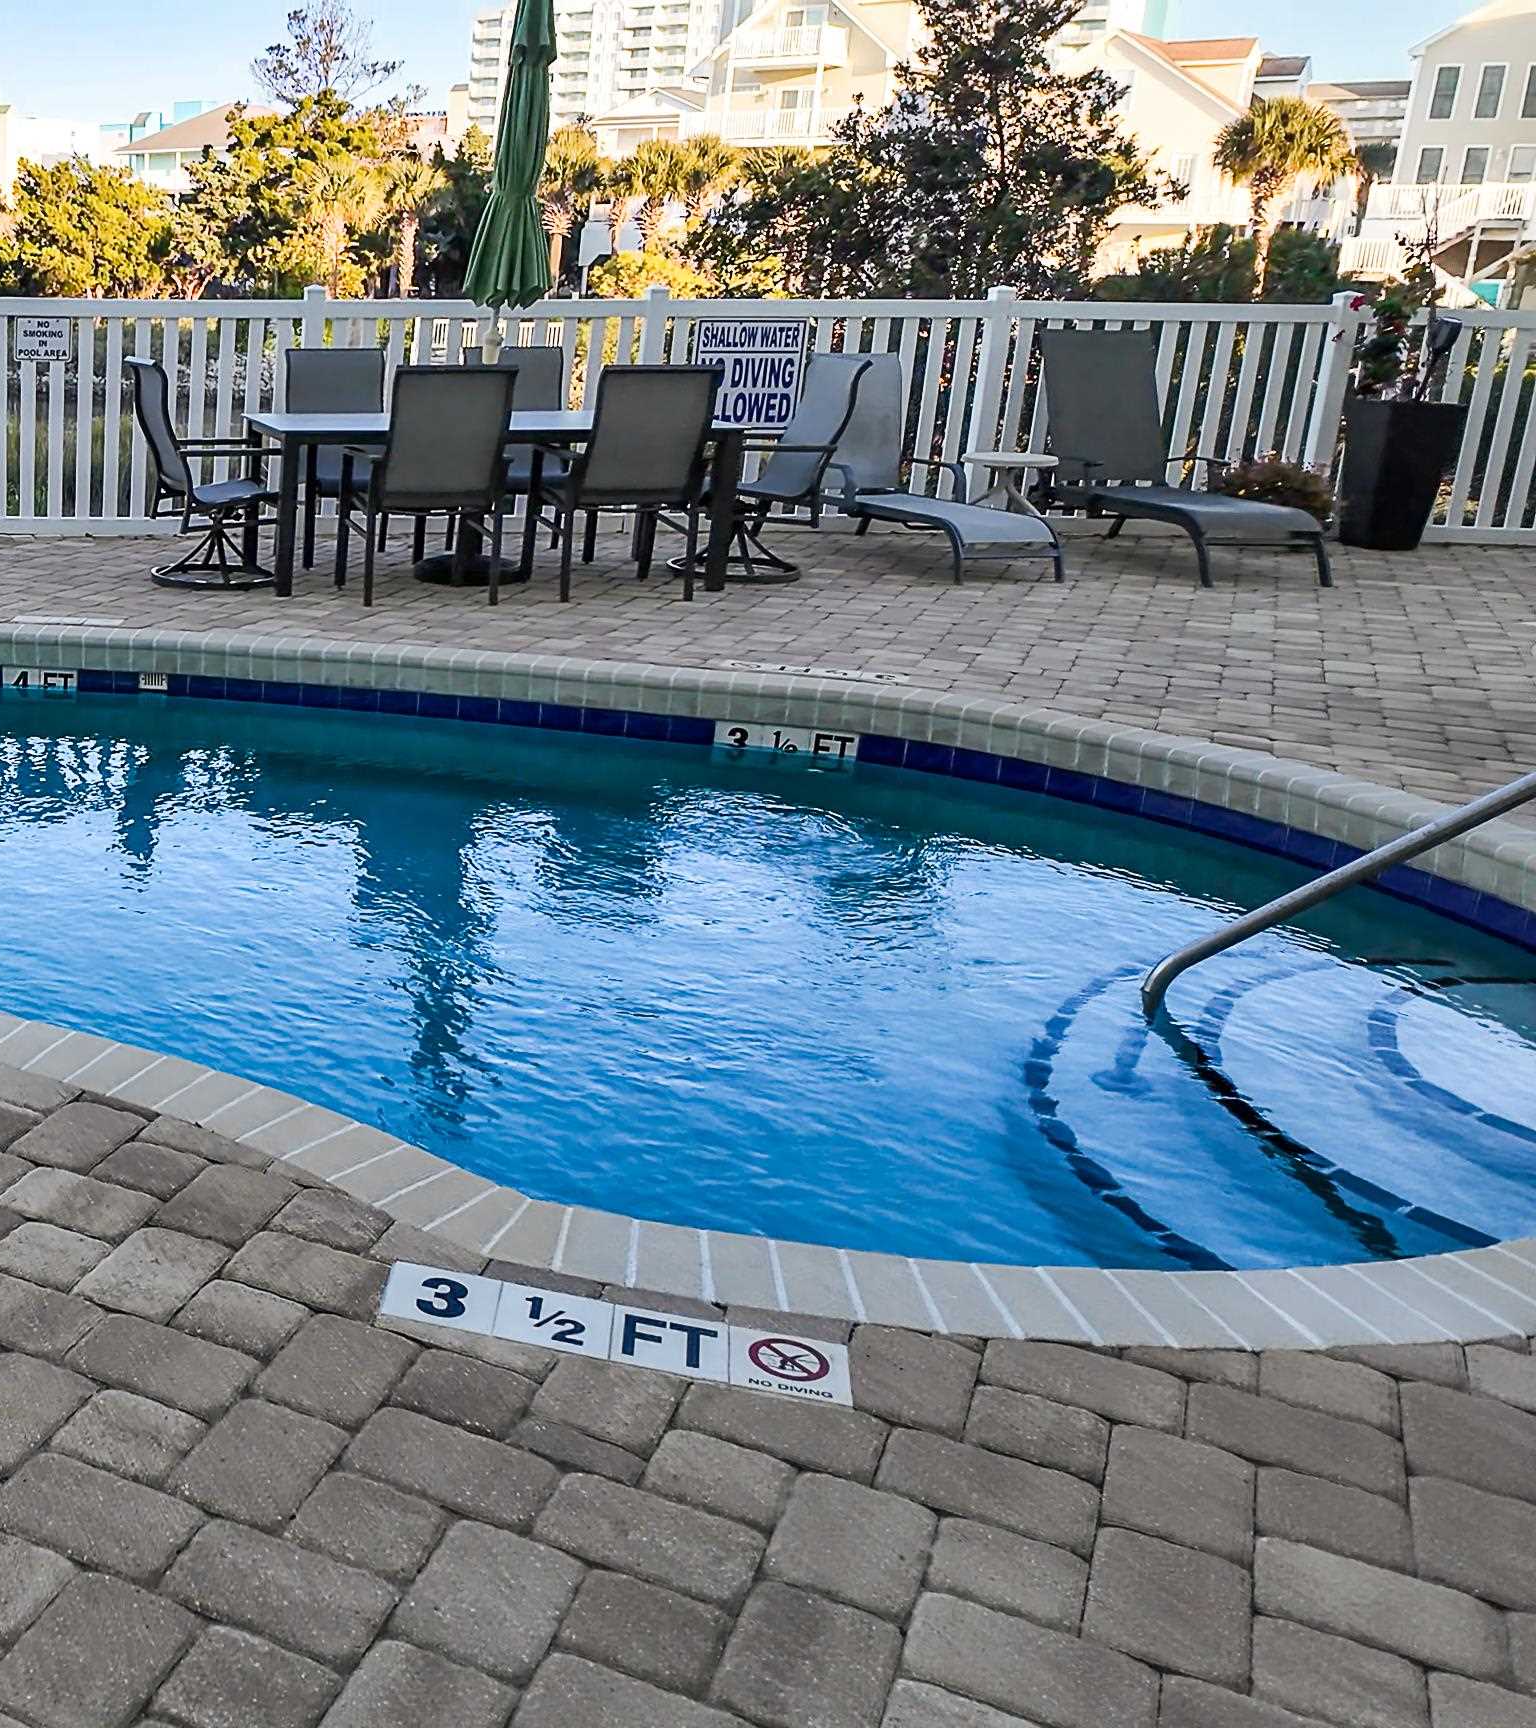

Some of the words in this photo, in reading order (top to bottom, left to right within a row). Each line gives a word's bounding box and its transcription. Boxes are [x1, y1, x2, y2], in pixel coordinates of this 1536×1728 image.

[23, 330, 64, 338] SMOKING
[703, 326, 758, 348] SHALLOW
[760, 326, 800, 348] WATER
[730, 357, 795, 389] DIVING
[713, 392, 791, 423] LOWED
[10, 670, 30, 688] 4
[43, 672, 75, 690] FT
[727, 727, 749, 748] 3
[814, 733, 855, 758] FT
[416, 1277, 469, 1318] 3
[621, 1314, 718, 1369] FT
[748, 1378, 773, 1388] NO
[777, 1383, 834, 1399] DIVING
